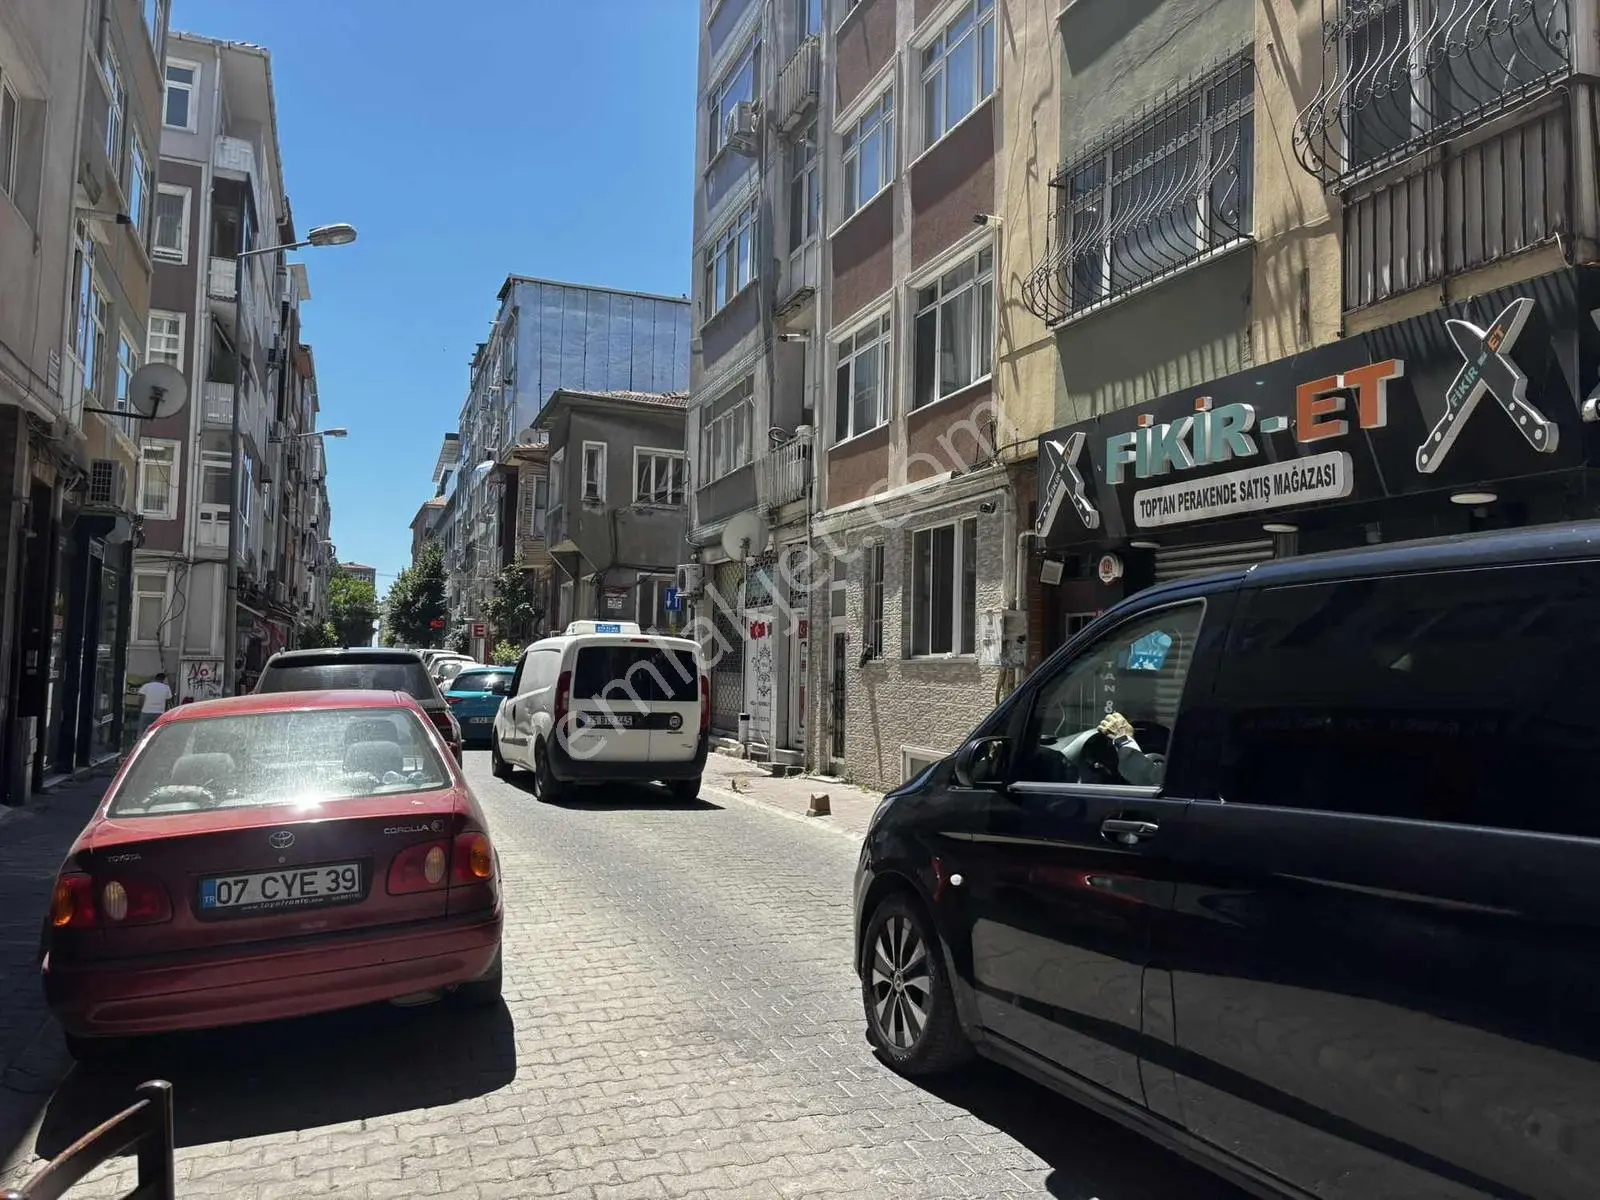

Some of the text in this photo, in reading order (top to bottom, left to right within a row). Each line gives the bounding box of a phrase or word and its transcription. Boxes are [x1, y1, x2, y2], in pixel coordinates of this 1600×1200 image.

[1140, 463, 1336, 519] TOPTAN PERAKENDE SATIŞ MAĞAZASI
[383, 824, 429, 835] COROLLA
[216, 879, 249, 905] 07
[261, 871, 319, 900] CYE
[326, 868, 356, 893] 39
